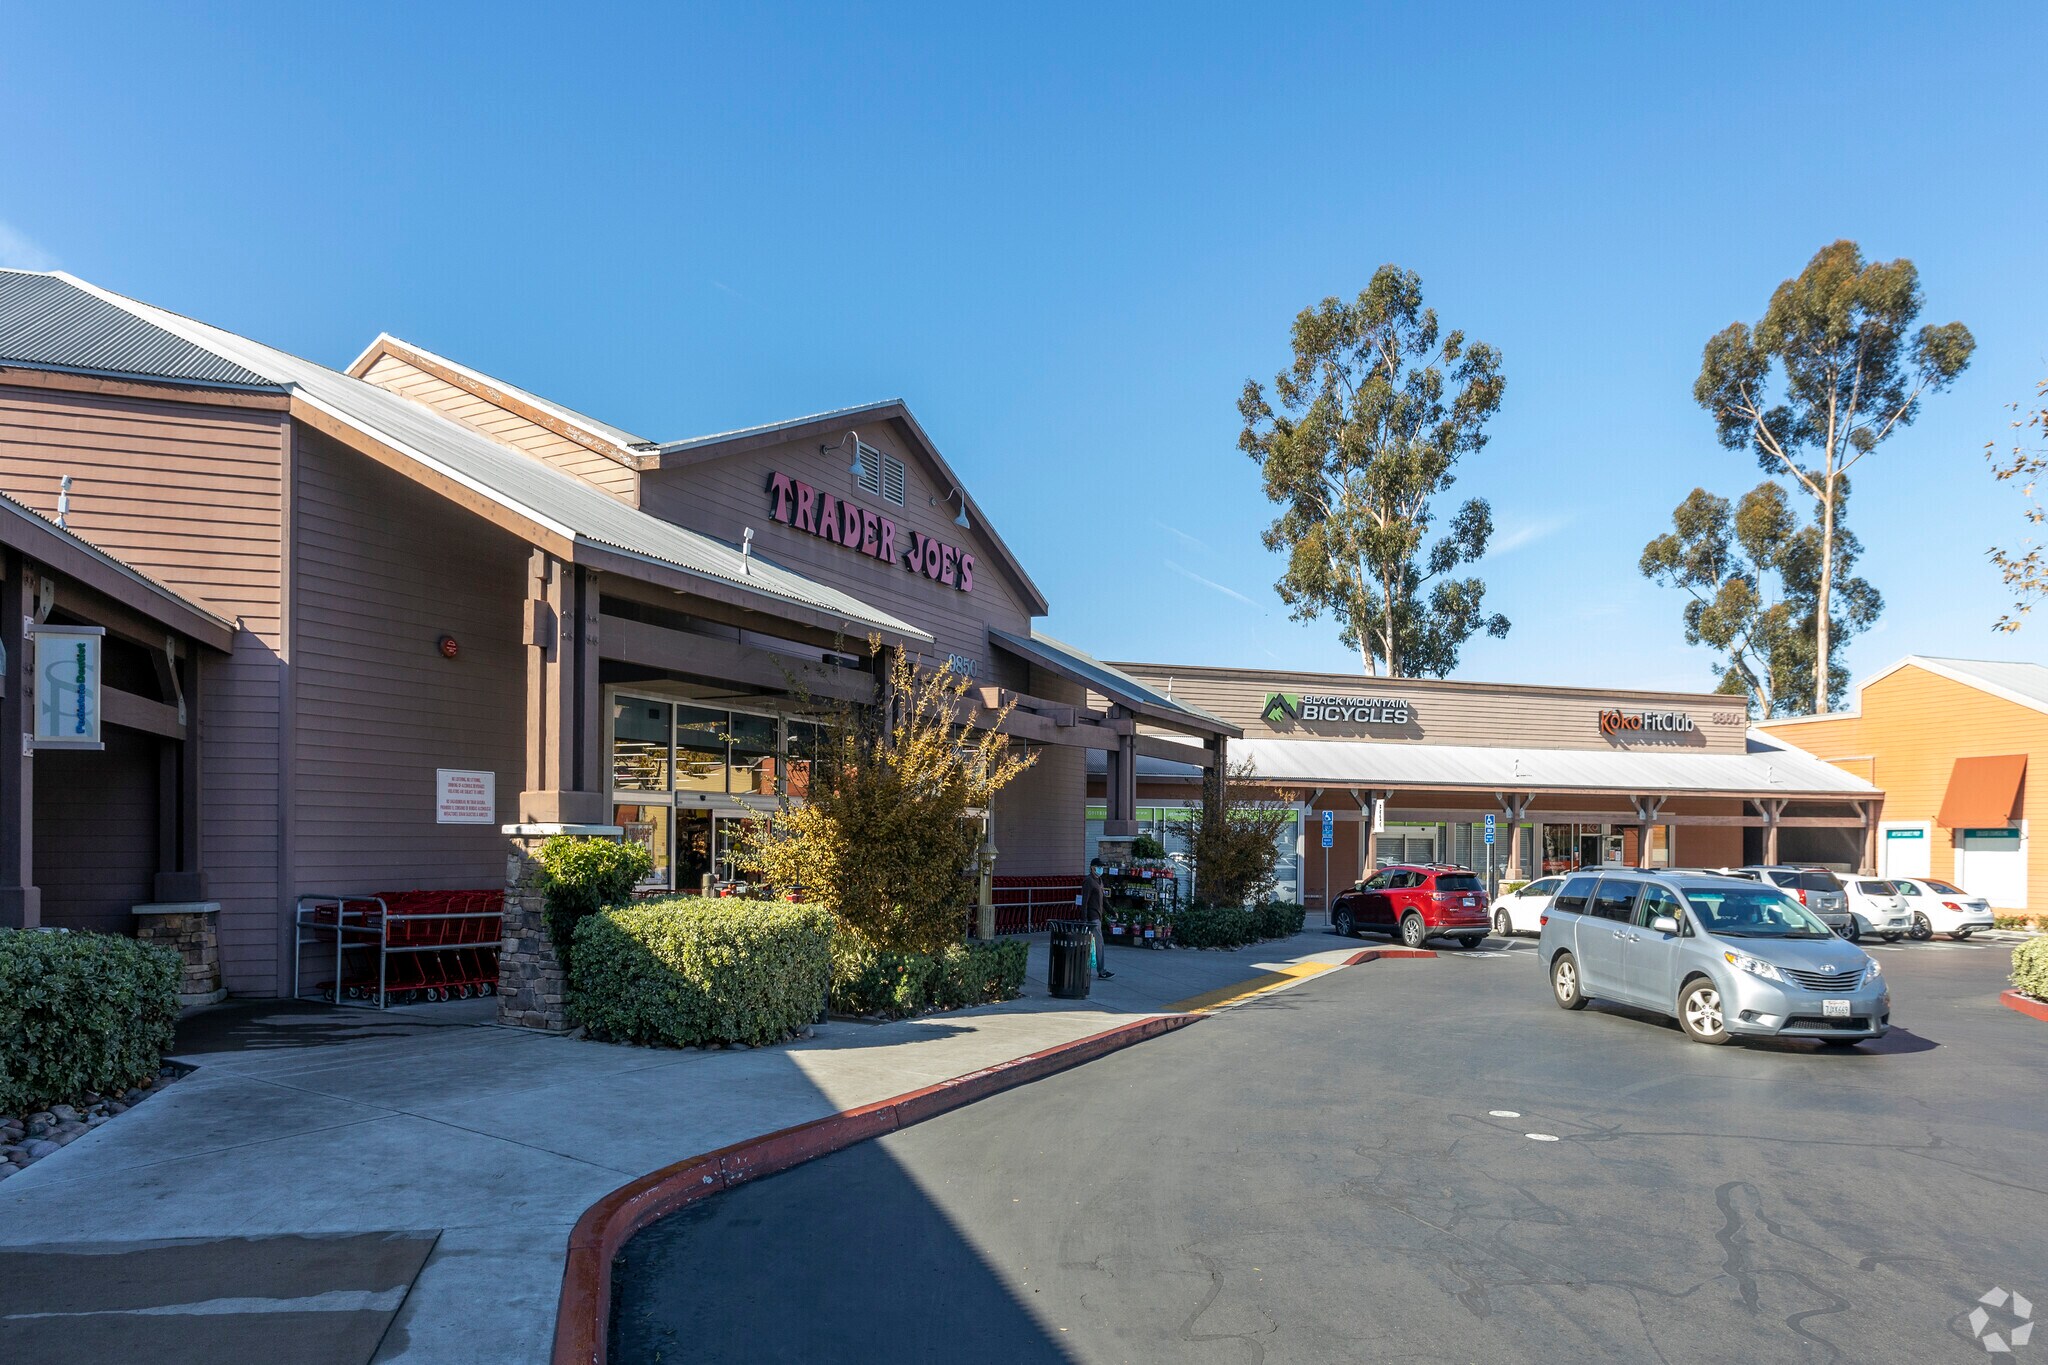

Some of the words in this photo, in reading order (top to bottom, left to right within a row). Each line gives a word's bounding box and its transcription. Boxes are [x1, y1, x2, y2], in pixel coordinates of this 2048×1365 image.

[765, 471, 897, 564] TRADER
[903, 530, 975, 592] JOE'S
[76, 642, 86, 683] Dentist
[948, 653, 978, 678] 9850
[1304, 695, 1343, 705] BLACK
[1346, 697, 1408, 708] MOUNTAIN
[1302, 705, 1409, 724] BICYCLES
[1600, 710, 1642, 735] Koko
[1643, 712, 1695, 732] FitClub
